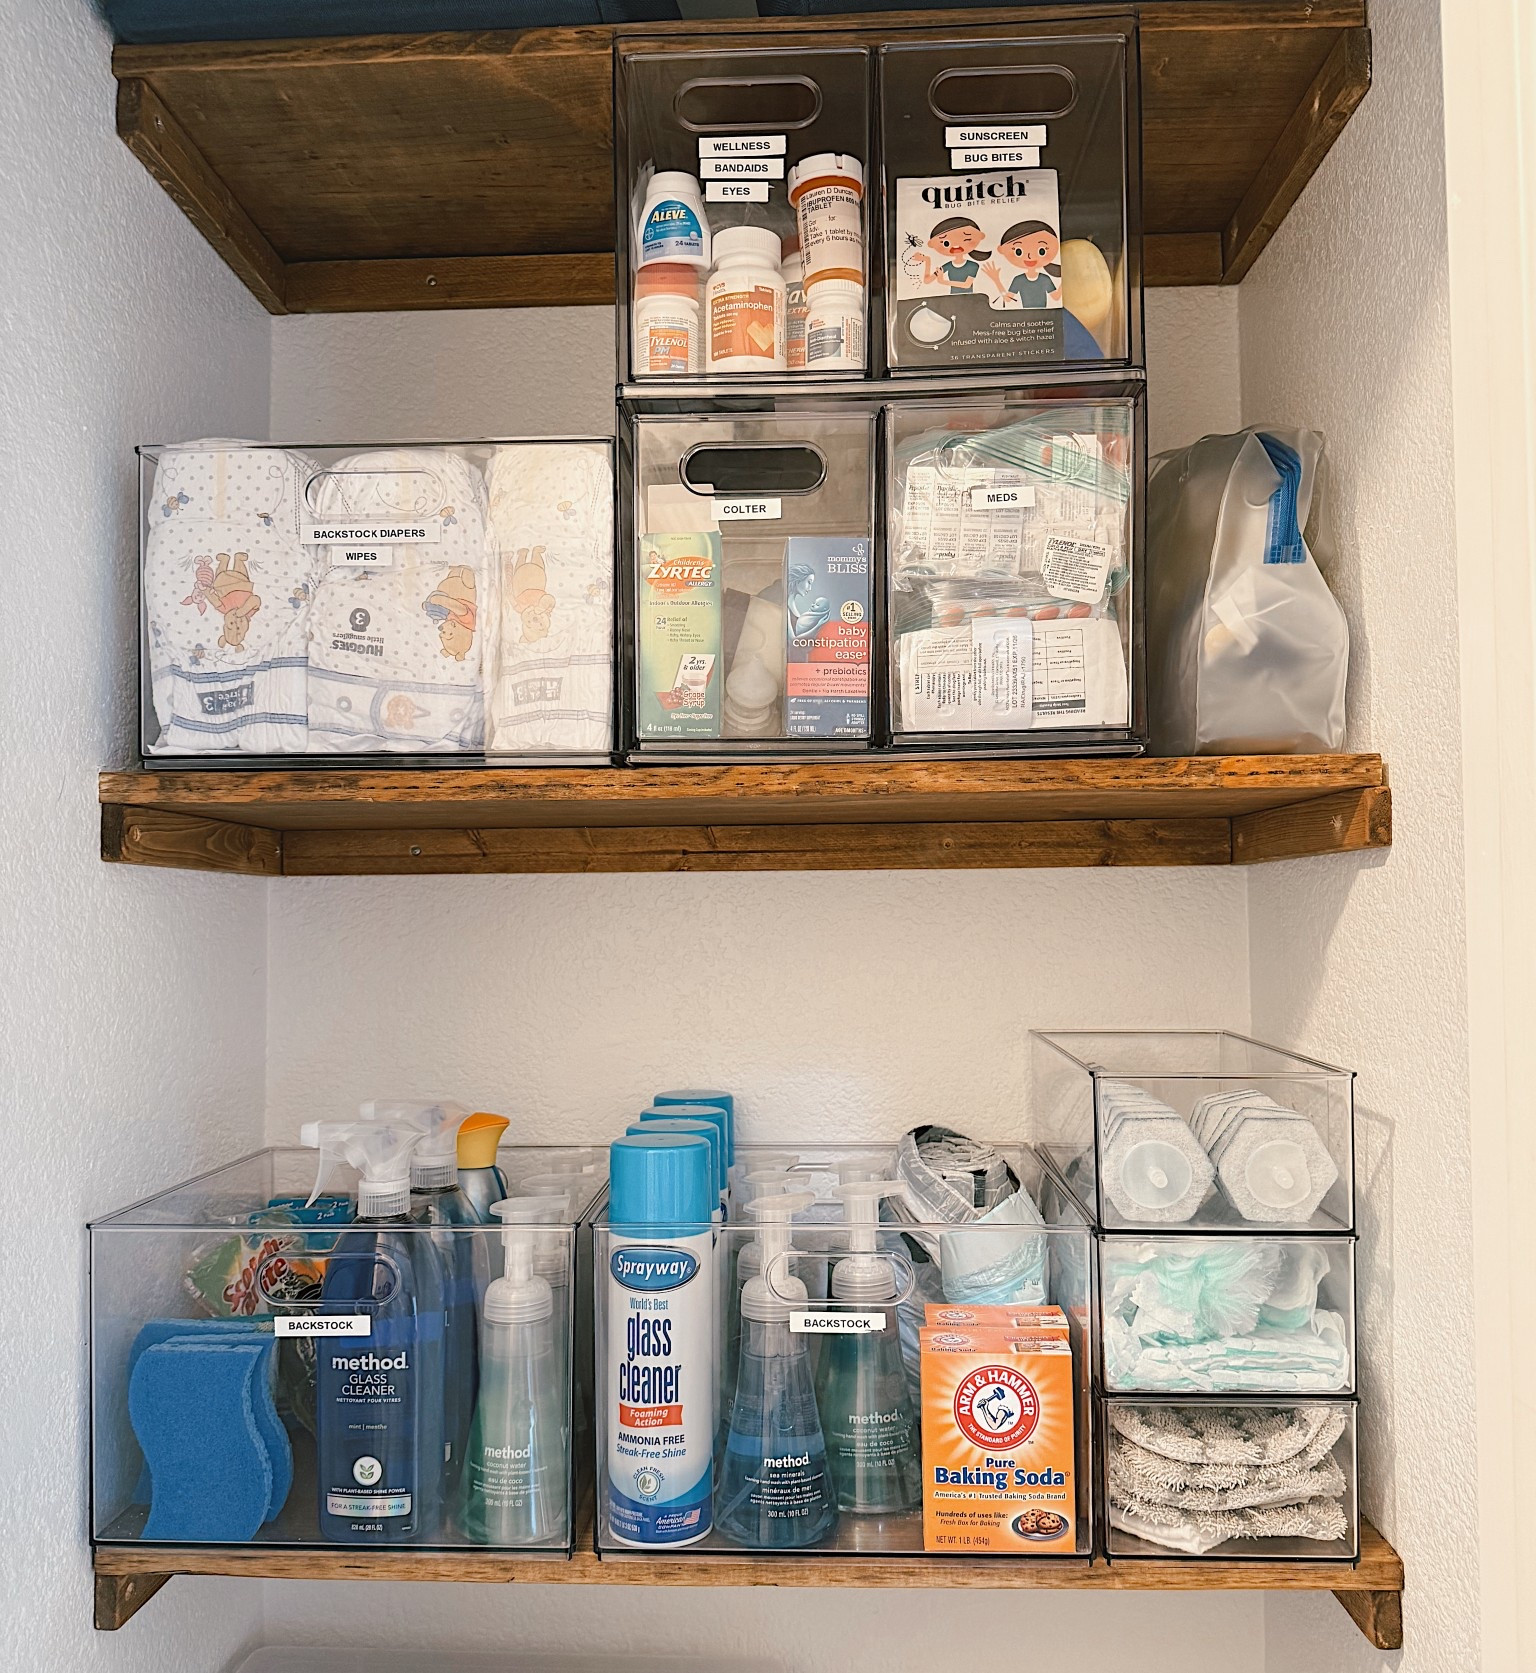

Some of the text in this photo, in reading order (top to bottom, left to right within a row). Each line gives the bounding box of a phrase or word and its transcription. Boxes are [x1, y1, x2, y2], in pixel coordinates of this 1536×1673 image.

[959, 131, 1029, 141] SUNSCREEN
[713, 141, 771, 151] WELLNESS
[964, 153, 1023, 162] BUG BITES
[714, 164, 769, 172] BANDAIDS
[722, 187, 751, 195] EYES
[921, 175, 1028, 209] quitch
[807, 196, 845, 208] IBUPROFEN
[990, 197, 1021, 205] RELIEF
[807, 202, 832, 214] TABLET
[651, 209, 687, 224] ALEVE
[810, 231, 823, 240] Take
[809, 238, 825, 247] every
[713, 300, 773, 314] Acetaminophen
[972, 326, 1055, 337] Mess-free bug bite relief
[650, 336, 688, 348] TYLENOL
[961, 348, 1055, 360] TRANSPARENT STICKERS
[987, 493, 1018, 502] MEDS
[723, 505, 767, 514] COLTER
[313, 529, 426, 539] BACKSTOCK DIAPERS
[345, 552, 377, 561] WIPES
[647, 563, 713, 580] ZYRTEC
[827, 563, 868, 574] BLISS
[846, 602, 856, 612] #1
[355, 612, 366, 625] 3
[656, 617, 667, 625] 24
[838, 626, 867, 638] baby
[366, 636, 385, 644] little
[792, 638, 867, 648] constipation
[332, 639, 384, 657] HUGGIES
[688, 656, 697, 664] 2
[823, 668, 867, 676] prebiotics
[683, 690, 705, 699] Grape
[683, 700, 705, 708] Syrup
[617, 1254, 689, 1281] Sprayway
[629, 1296, 669, 1311] World's Best
[288, 1321, 354, 1330] BACKSTOCK
[804, 1318, 871, 1329] BACKSTOCK
[627, 1311, 672, 1361] glass
[349, 1374, 388, 1385] GLASS
[619, 1360, 681, 1404] cleaner
[341, 1385, 395, 1396] CLEANER
[959, 1370, 1035, 1416] ARM & HAMMER
[630, 1408, 669, 1418] Foaming
[848, 1408, 898, 1424] method
[634, 1417, 663, 1427] Action
[618, 1431, 685, 1446] AMMONIA FREE
[967, 1423, 976, 1434] THE
[976, 1430, 1004, 1444] STANDARD
[1010, 1424, 1026, 1440] PURITY
[484, 1443, 531, 1459] method
[616, 1443, 687, 1459] Streak-Free Shine
[986, 1457, 1016, 1468] Pure
[649, 1466, 666, 1482] FRESH
[781, 1470, 805, 1478] minerals
[935, 1467, 1065, 1490] Baking Soda
[639, 1494, 658, 1502] SCENT
[934, 1491, 967, 1499] America's
[1004, 1492, 1027, 1500] Baking
[935, 1510, 968, 1519] Hundreds
[968, 1511, 977, 1519] of
[979, 1519, 1001, 1528] Baking
[936, 1535, 947, 1544] NET
[947, 1535, 958, 1544] WT.
[958, 1536, 962, 1544] 1
[972, 1536, 990, 1546] (454g)
